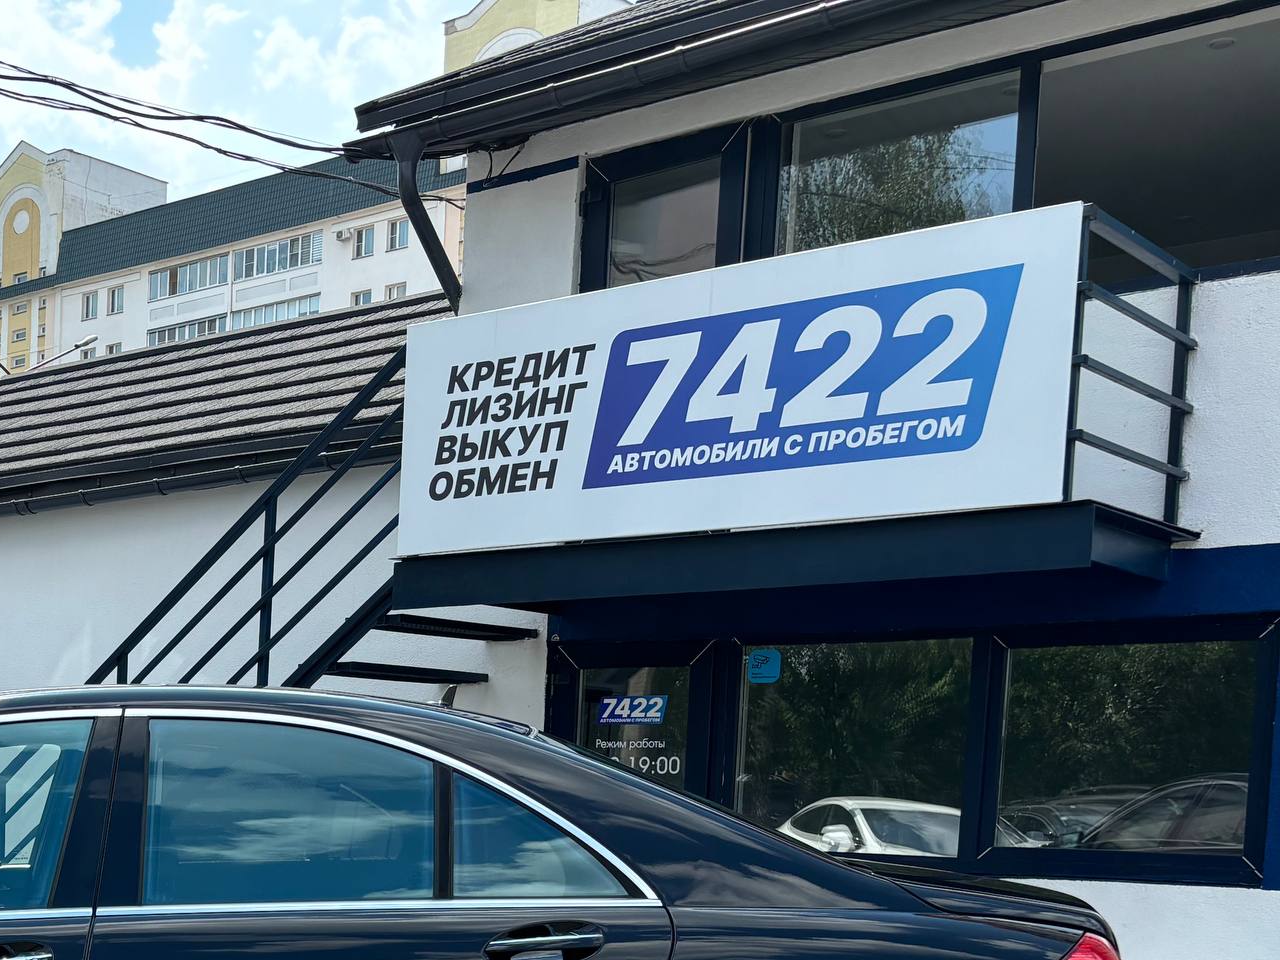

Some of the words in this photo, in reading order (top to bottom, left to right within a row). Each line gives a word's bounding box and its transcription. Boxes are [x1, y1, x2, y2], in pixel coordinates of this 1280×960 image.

[446, 343, 597, 395] КРЕДИТ
[616, 287, 988, 447] 7422
[440, 381, 588, 430] ЛИЗИНГ
[434, 420, 569, 466] ВЫКУП
[606, 437, 780, 475] АВТОМОБИЛИ
[784, 434, 804, 454] С
[807, 414, 967, 453] ПРОБЕГОМ
[428, 458, 559, 502] ОБМЕН
[601, 697, 663, 718] 7422
[595, 739, 627, 749] Режим
[629, 738, 666, 750] работы
